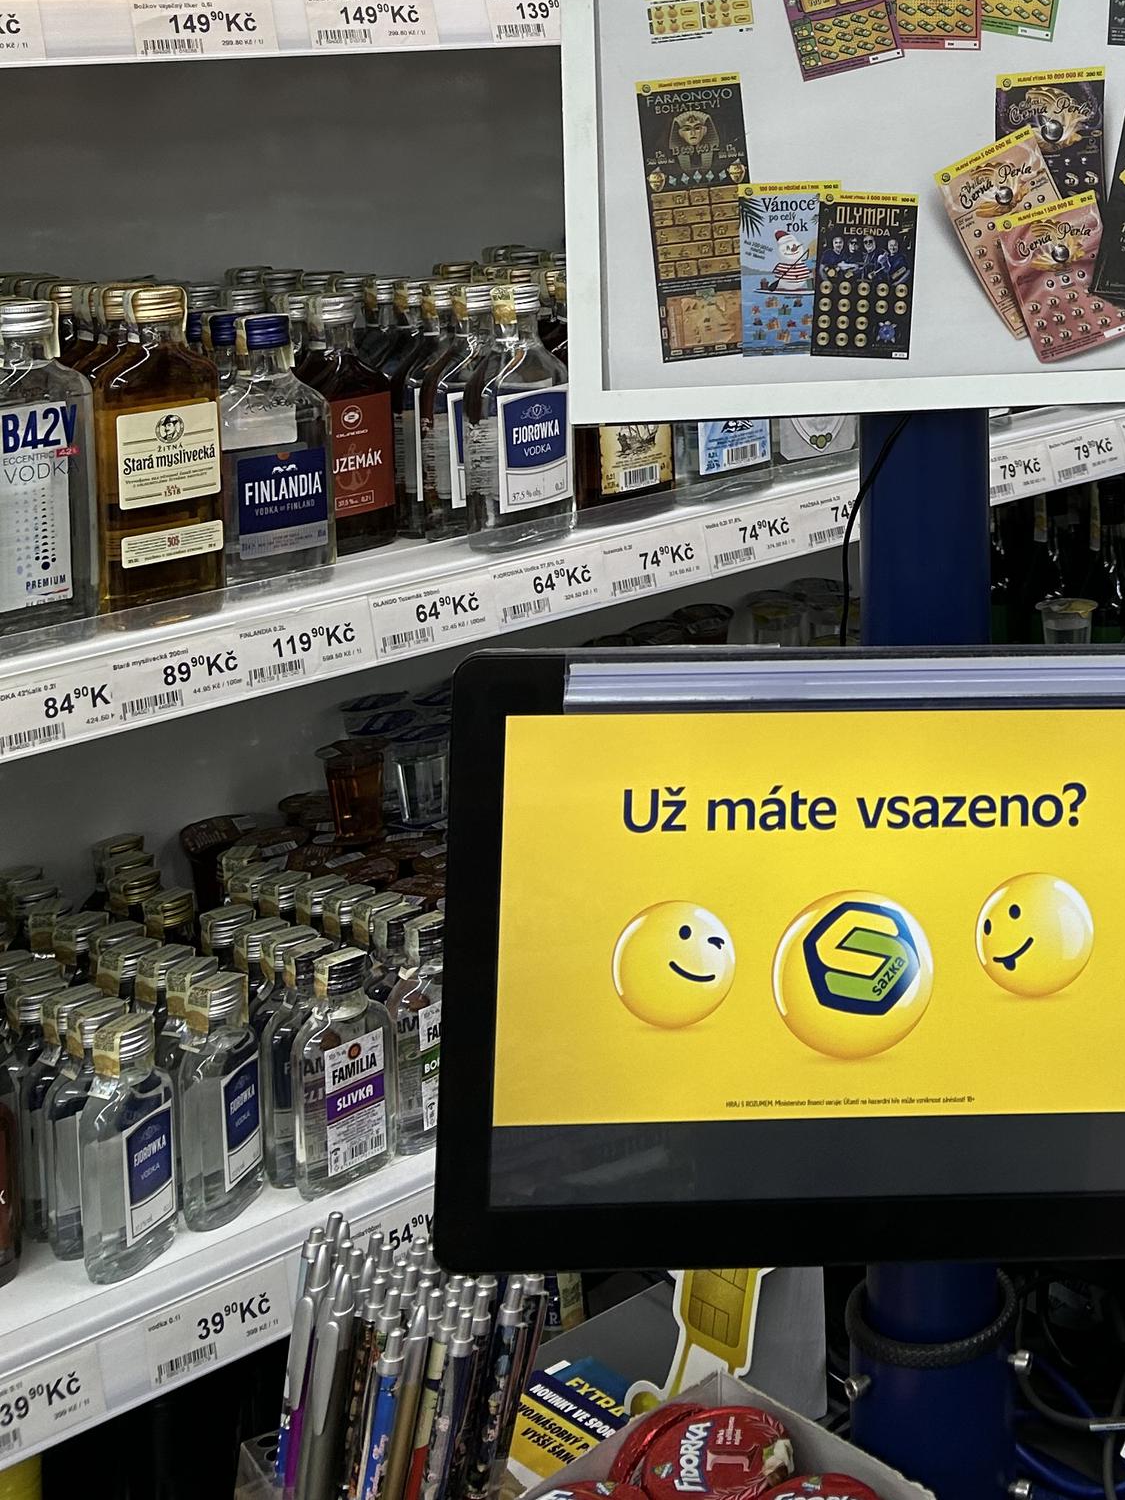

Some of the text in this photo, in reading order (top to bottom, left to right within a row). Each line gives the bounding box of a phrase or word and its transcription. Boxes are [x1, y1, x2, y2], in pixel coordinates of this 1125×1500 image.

[646, 87, 732, 107] FARAONOVO
[761, 197, 816, 212] Vánoce
[768, 214, 779, 224] po
[786, 219, 809, 233] rok
[835, 207, 899, 226] OLYMPIC
[844, 226, 890, 237] LEGENDA
[123, 444, 215, 476] Stará myslivecká
[524, 443, 552, 457] VODKA
[244, 470, 323, 506] FINLANDIA
[26, 574, 66, 591] PREMIUM
[623, 782, 1087, 833] Už máte vsazeno?
[331, 1053, 377, 1085] FAMILIA
[335, 1083, 374, 1112] SLIVKA
[530, 1383, 590, 1421] NOVINKY VE
[675, 1421, 712, 1492] FIDORKA
